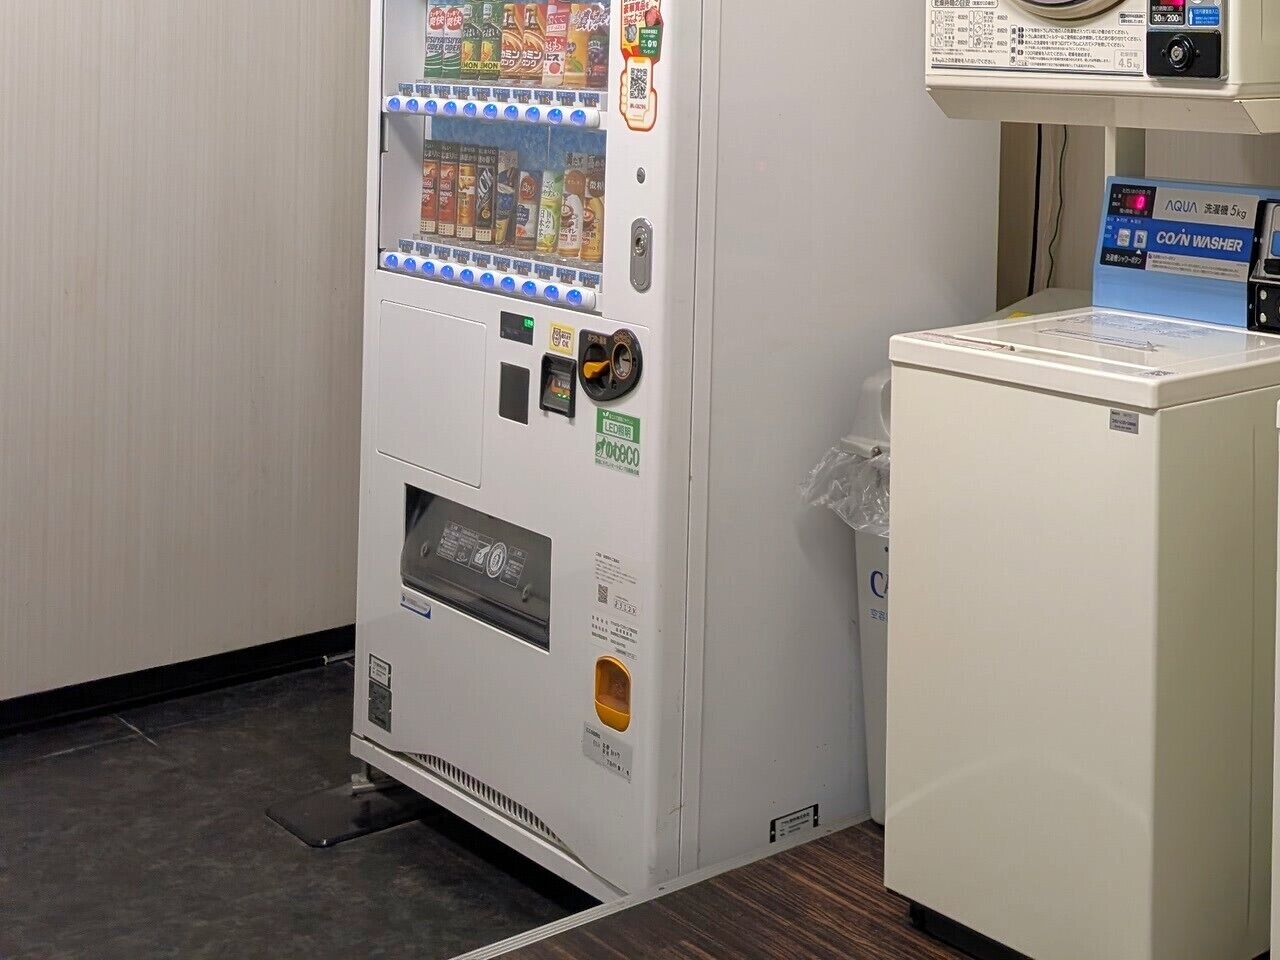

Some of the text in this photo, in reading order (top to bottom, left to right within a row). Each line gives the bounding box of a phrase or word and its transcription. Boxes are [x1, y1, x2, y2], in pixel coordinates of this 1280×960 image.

[1118, 58, 1133, 68] 4.5
[1165, 199, 1198, 214] AQUA
[1203, 203, 1247, 220] 洗濯機 5kg
[1192, 233, 1243, 253] WASHER
[605, 421, 632, 439] LED照明
[870, 570, 888, 599] C
